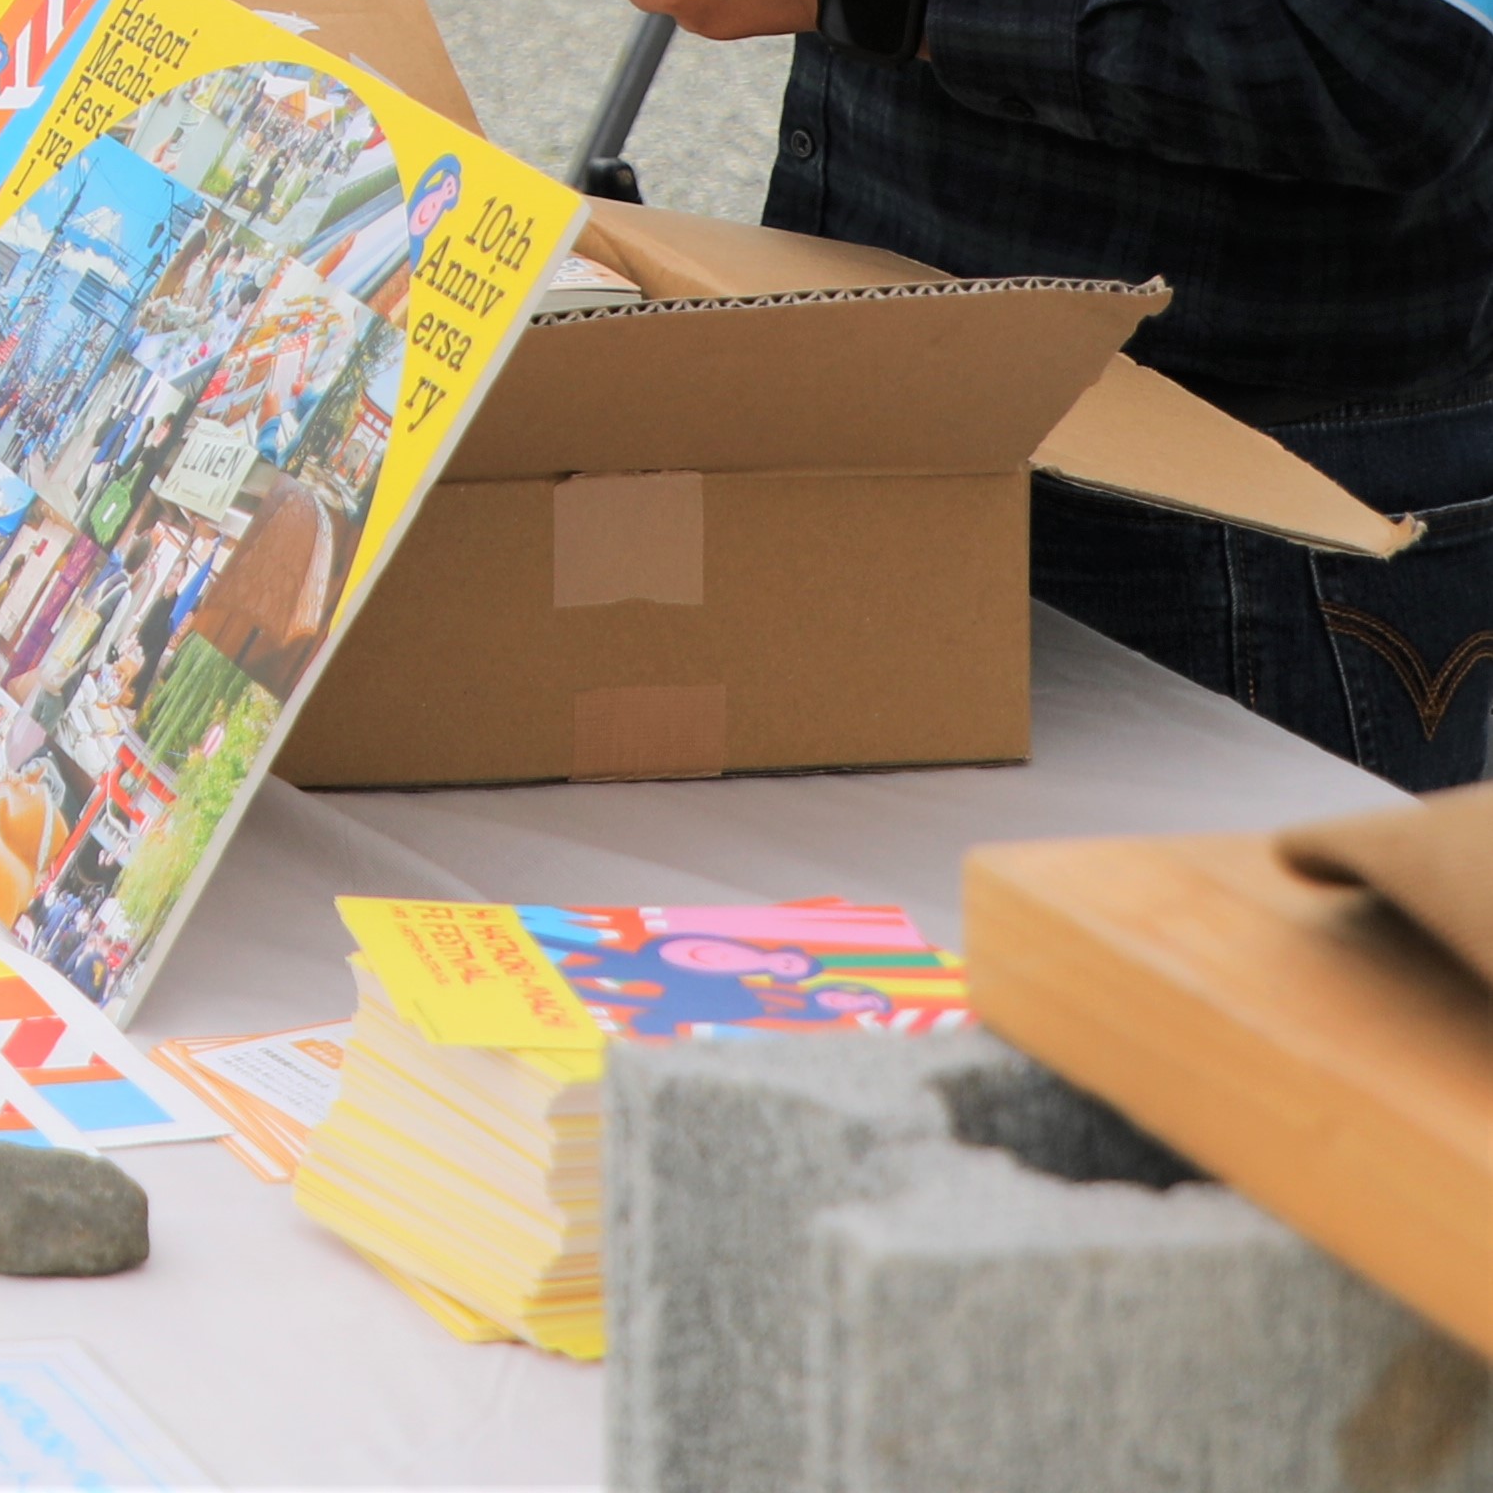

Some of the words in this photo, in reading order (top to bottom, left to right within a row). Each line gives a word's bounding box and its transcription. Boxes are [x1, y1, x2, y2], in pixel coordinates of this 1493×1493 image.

[63, 74, 116, 140] Fest
[38, 114, 75, 172] iva
[463, 195, 536, 273] 10th
[414, 234, 508, 320] Anniv
[410, 310, 475, 372] ersa
[402, 374, 448, 434] ry
[177, 431, 243, 481] LINEN
[420, 922, 499, 986] FESTIVAL
